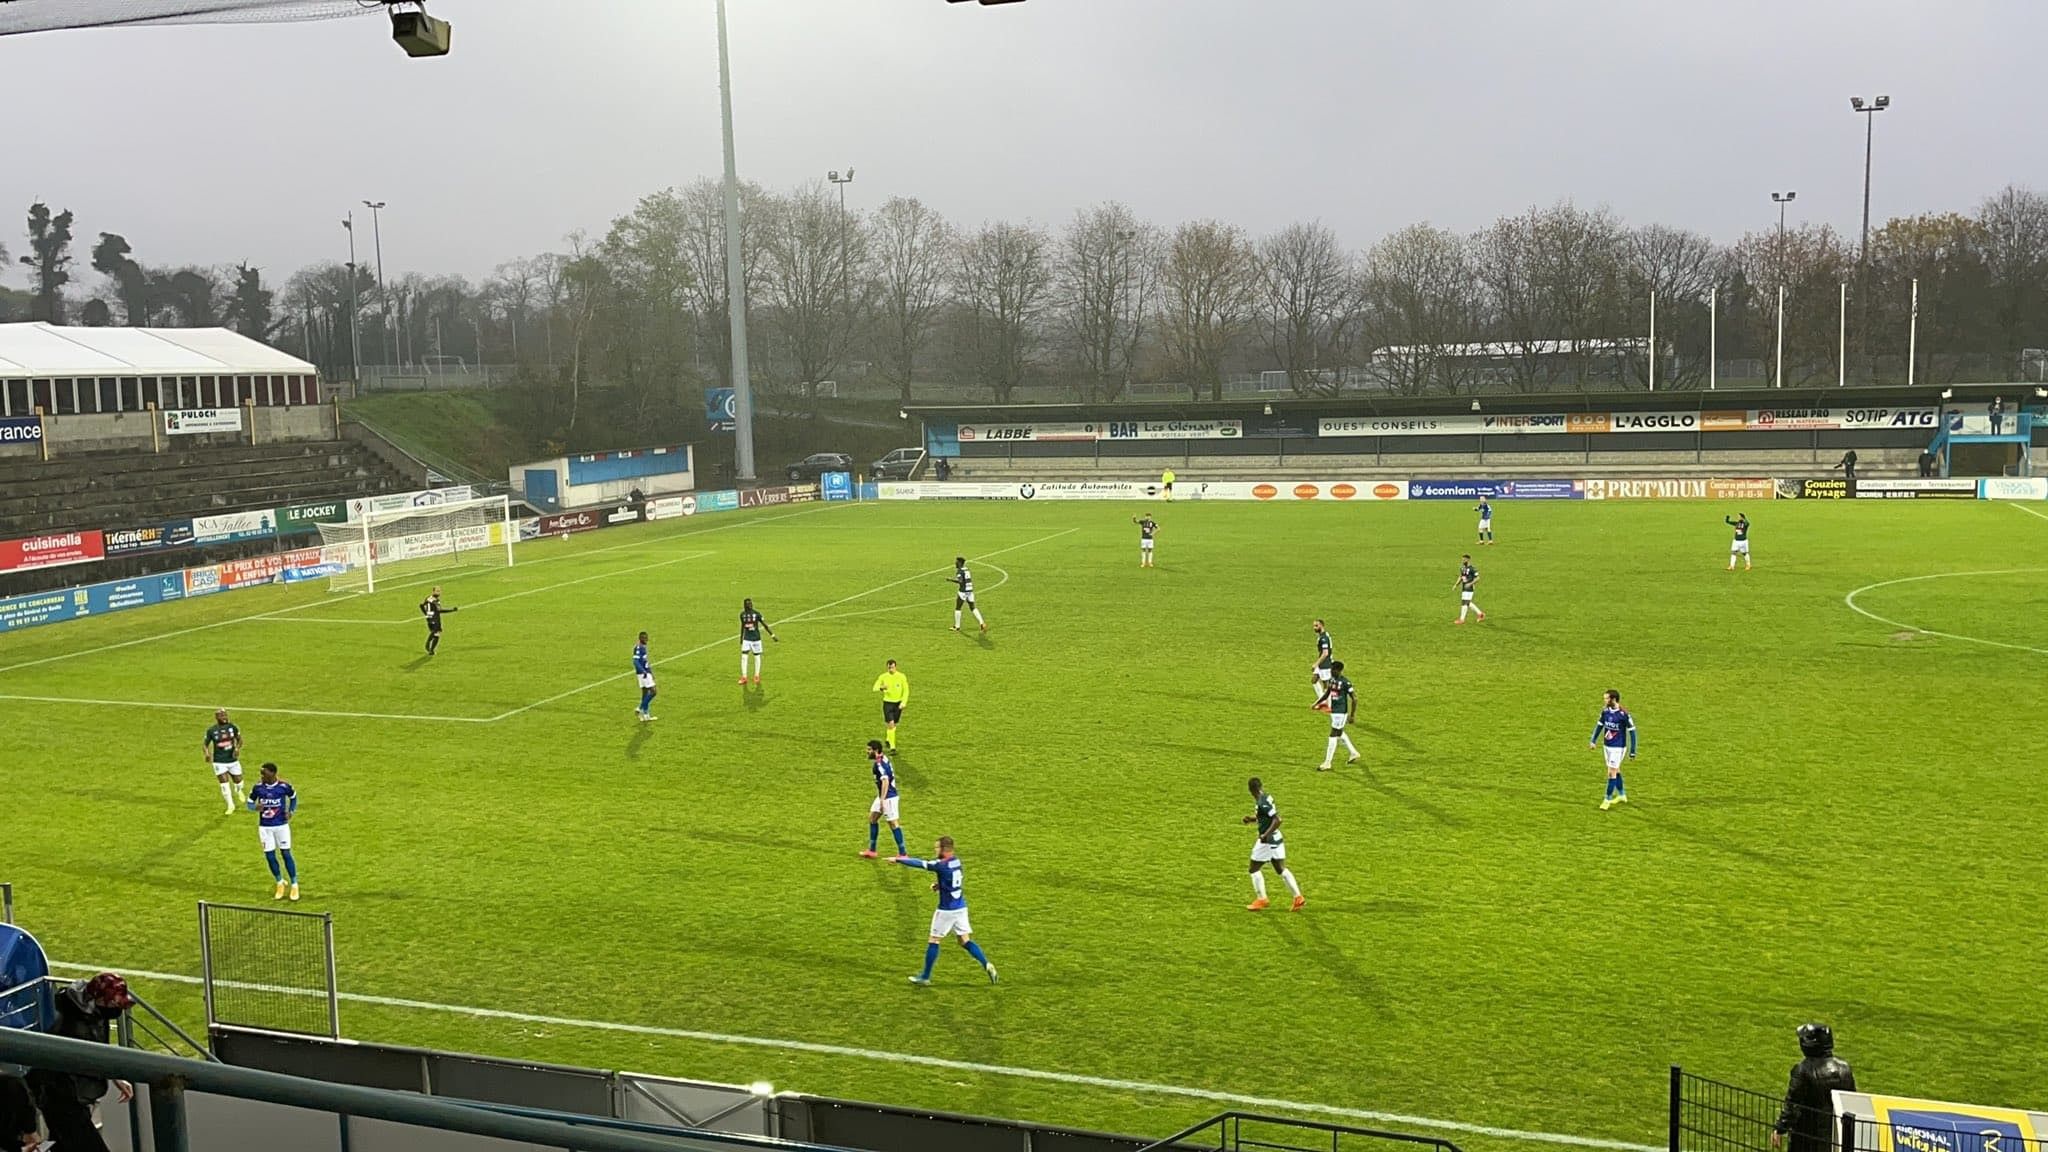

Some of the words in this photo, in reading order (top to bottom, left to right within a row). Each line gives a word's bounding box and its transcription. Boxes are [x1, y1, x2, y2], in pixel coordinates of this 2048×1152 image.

[181, 410, 217, 419] PULOCH
[1811, 409, 1830, 418] PRO
[1846, 409, 1888, 423] SOTIP
[1891, 411, 1934, 426] ATG
[1144, 421, 1165, 432] Les
[1168, 420, 1214, 432] Glénan
[1323, 422, 1366, 431] OUEST
[1372, 420, 1437, 431] CONSEILS
[1496, 415, 1565, 427] INTERSPORT
[1615, 415, 1695, 428] L'AGGLO
[986, 425, 1032, 439] LABBÉ
[1109, 422, 1139, 438] BAR
[1608, 480, 1706, 498] PRET'MIUM
[1804, 479, 1846, 488] Gouzien
[896, 487, 914, 495] suez
[1425, 486, 1476, 495] écomiam
[1804, 489, 1846, 499] Paysage
[740, 490, 755, 507] LA
[289, 510, 300, 520] LE
[302, 505, 336, 518] JOCKEY
[22, 533, 82, 551] cuisinella
[223, 563, 233, 574] LE
[234, 560, 253, 572] PRIX
[254, 558, 266, 569] DE
[283, 550, 320, 563] TRAVAUX
[242, 568, 267, 581] ENFIN
[301, 565, 337, 576] NATIONAL
